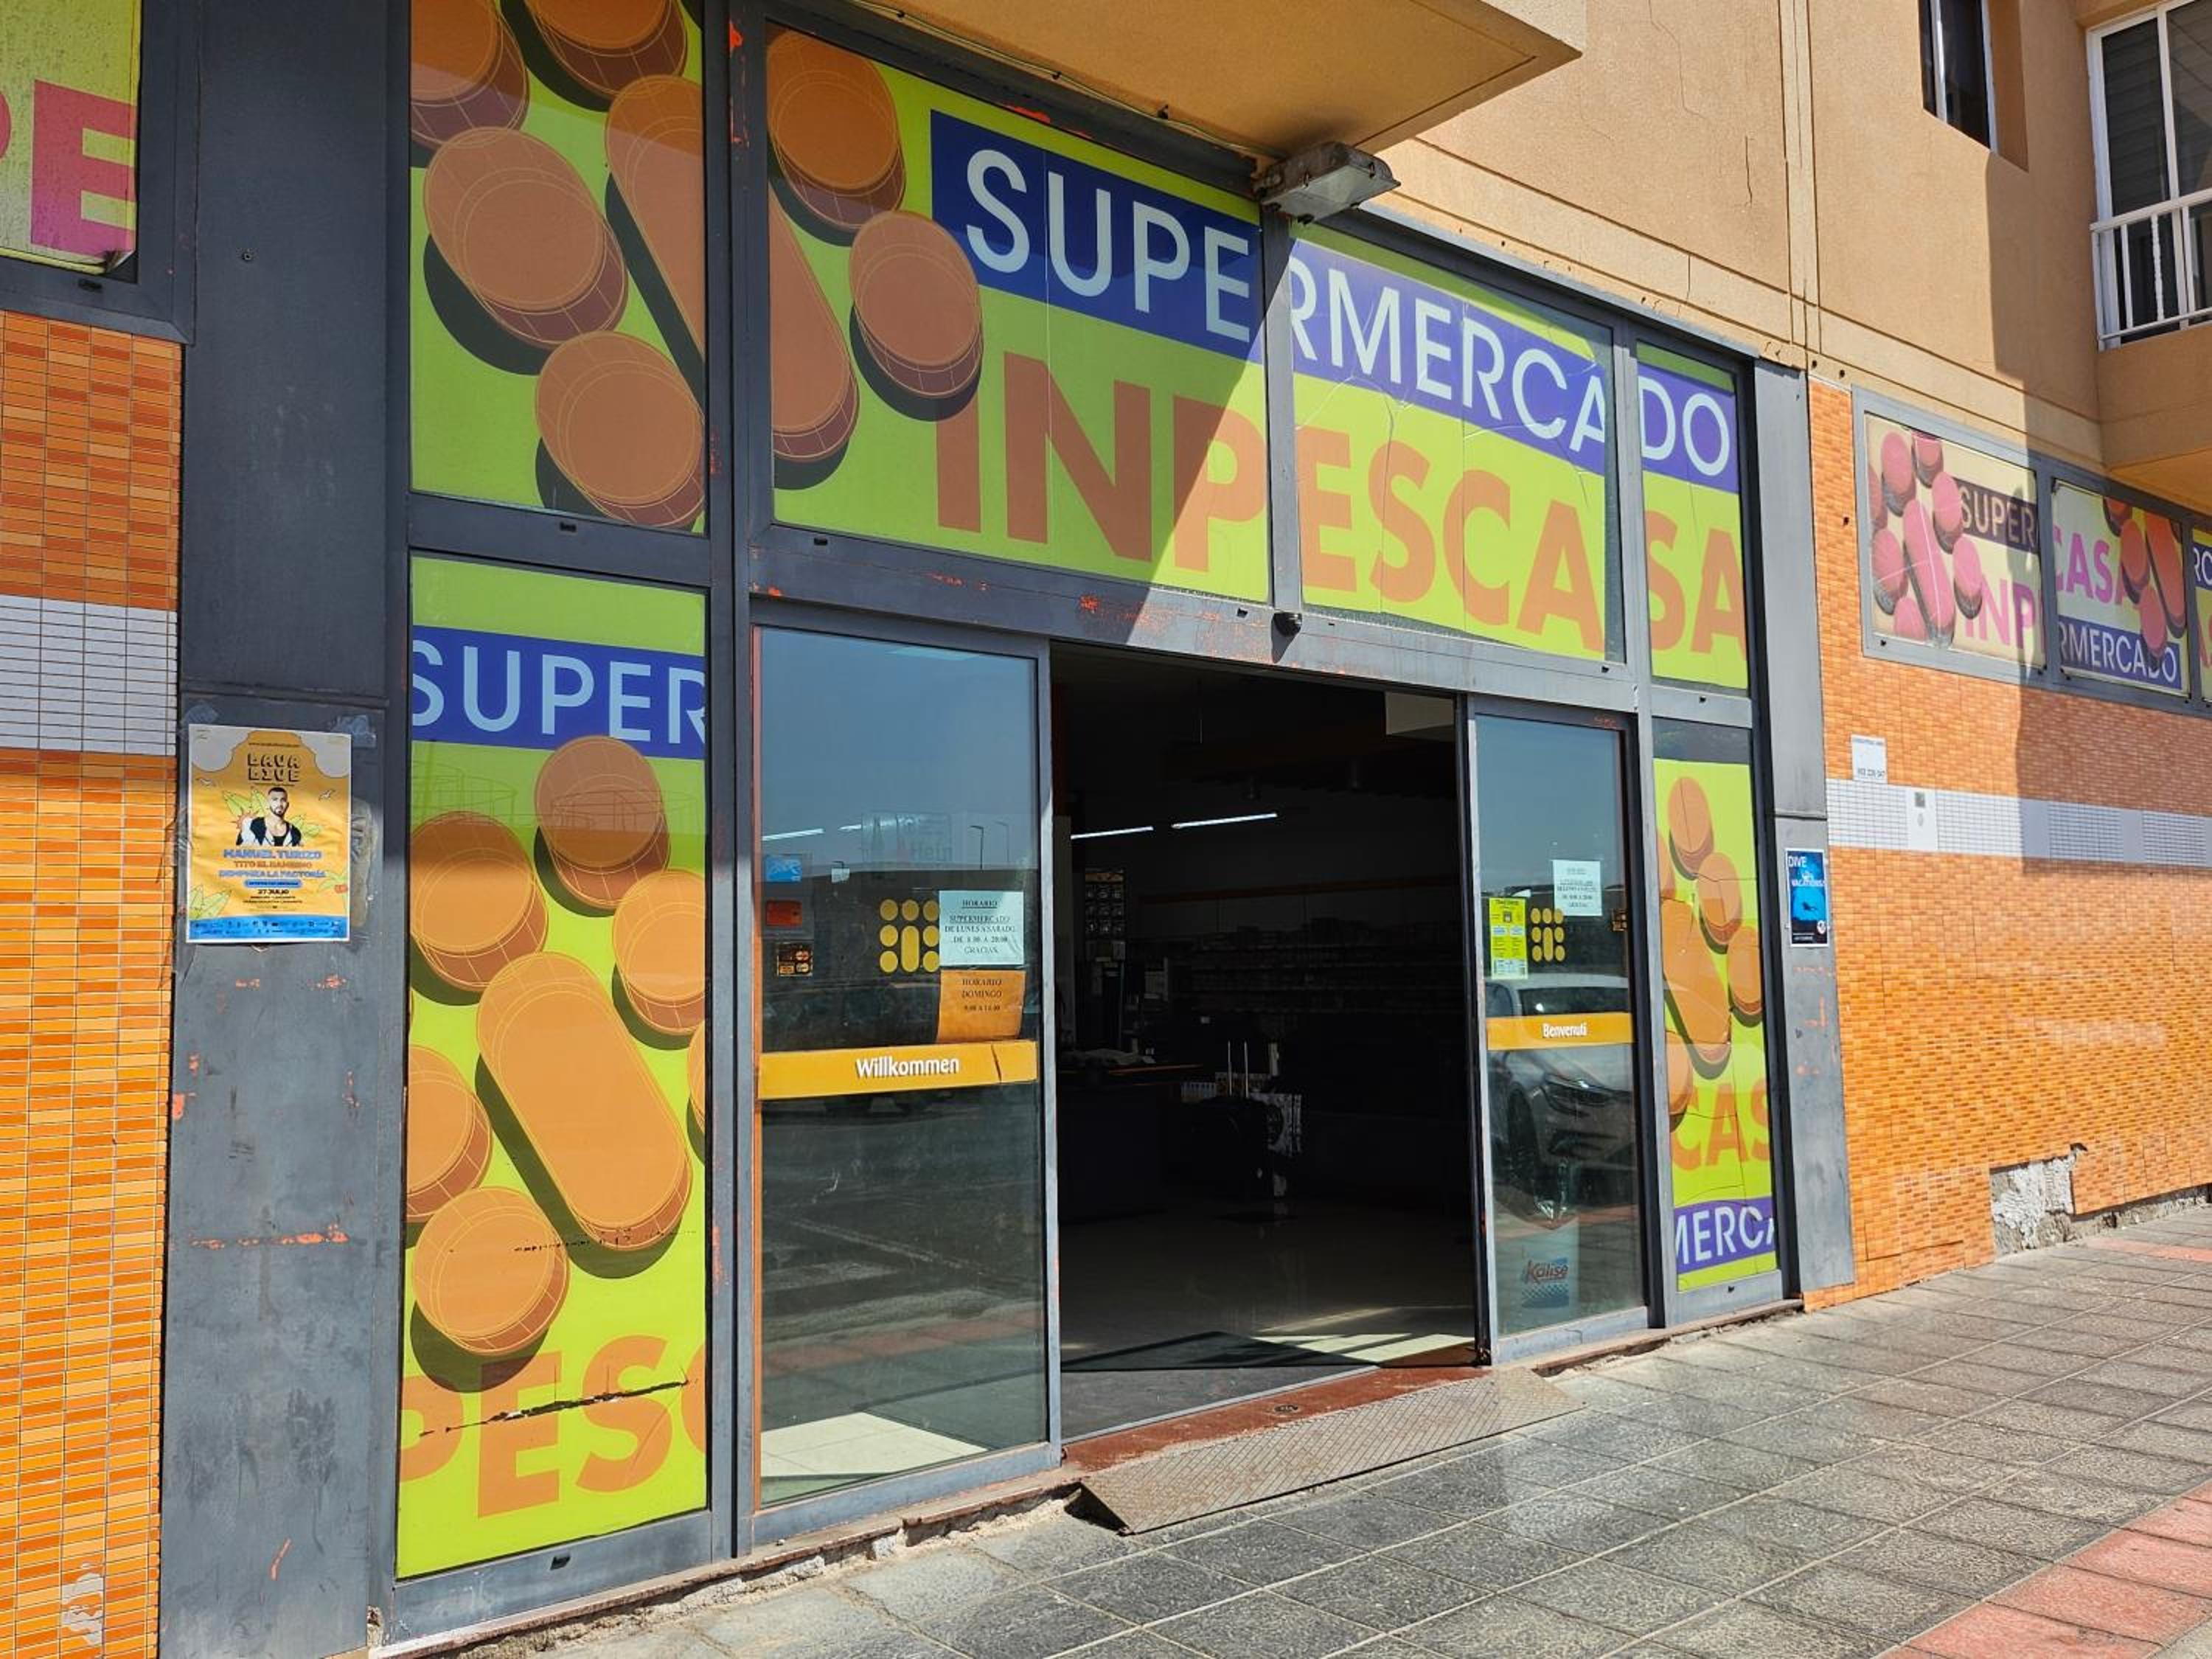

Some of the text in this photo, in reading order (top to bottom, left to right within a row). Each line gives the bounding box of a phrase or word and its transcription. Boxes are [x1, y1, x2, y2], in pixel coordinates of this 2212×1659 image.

[0, 80, 137, 258] E
[1959, 486, 2037, 546] SUPER
[2053, 524, 2128, 605] AS
[412, 639, 706, 744] SUPER
[961, 990, 1003, 998] DOMINGO
[1542, 1023, 1588, 1038] Benvenuti
[855, 1056, 961, 1078] Willkommen
